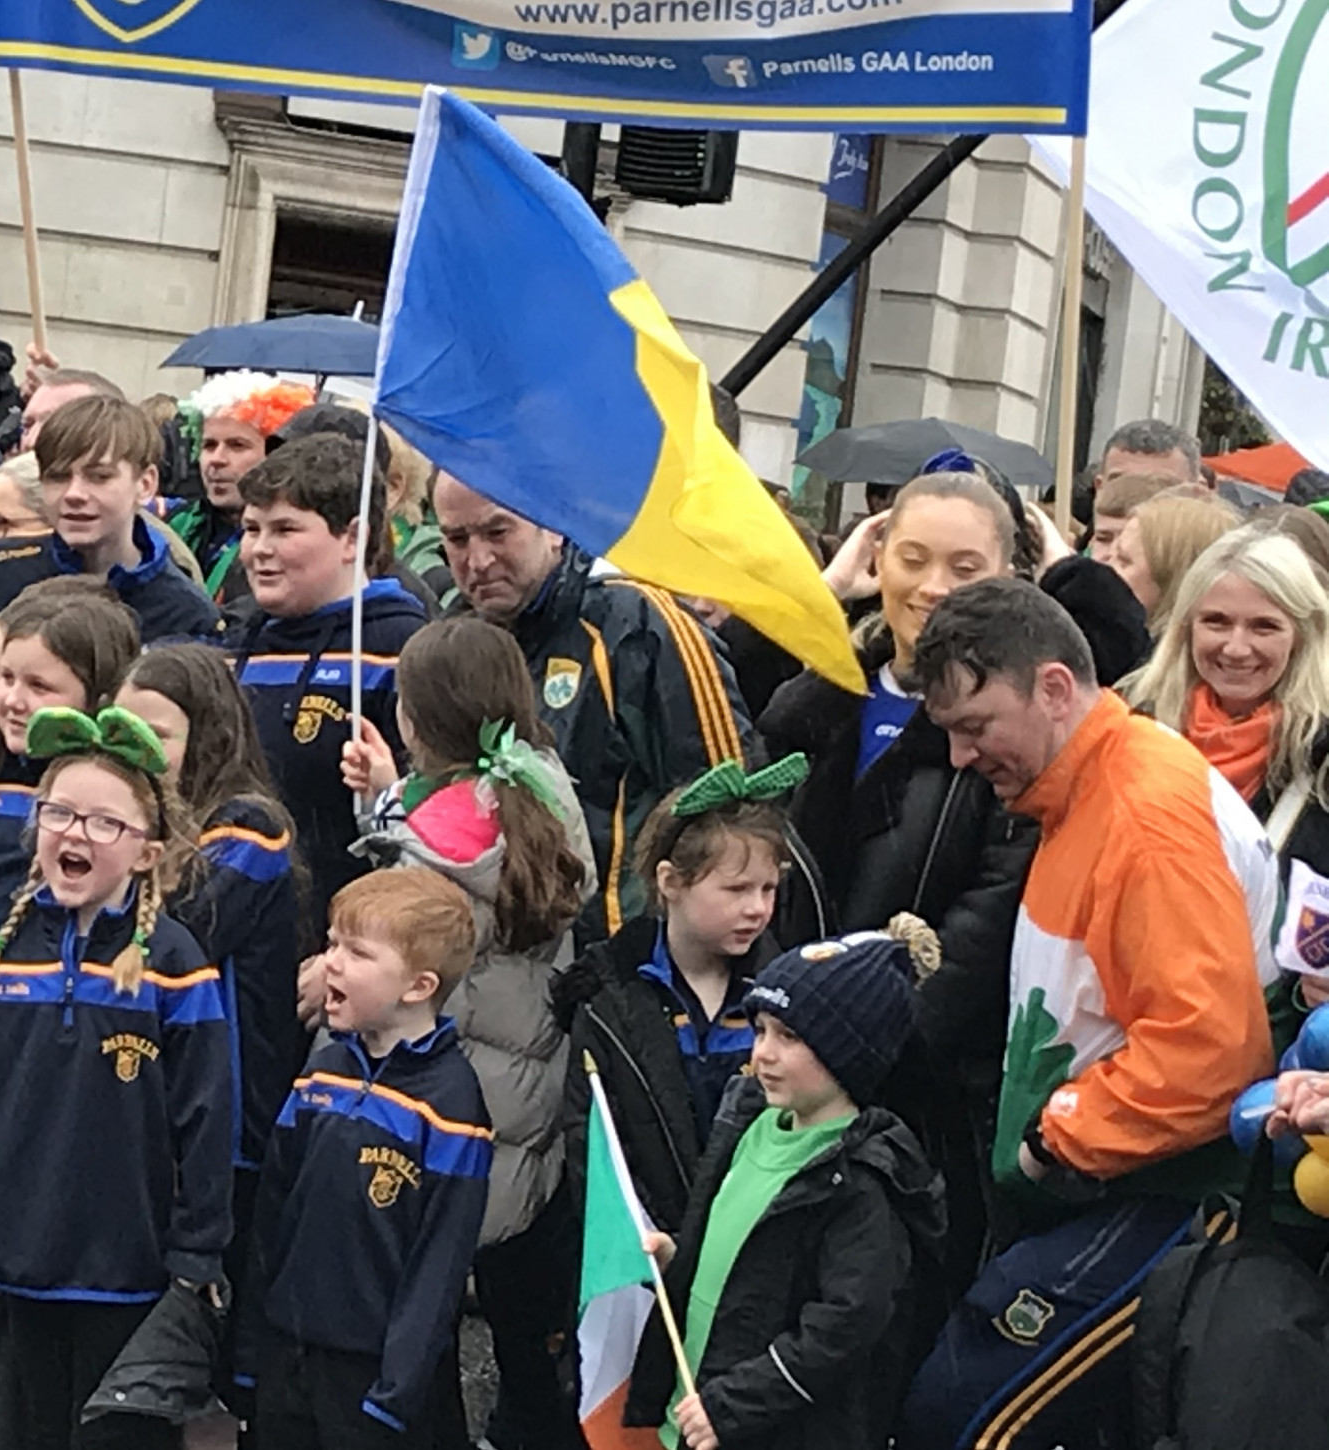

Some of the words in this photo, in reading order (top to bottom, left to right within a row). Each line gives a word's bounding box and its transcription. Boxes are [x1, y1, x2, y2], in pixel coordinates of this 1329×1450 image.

[762, 52, 855, 79] Parnells
[861, 50, 910, 73] GAA
[915, 51, 994, 72] London
